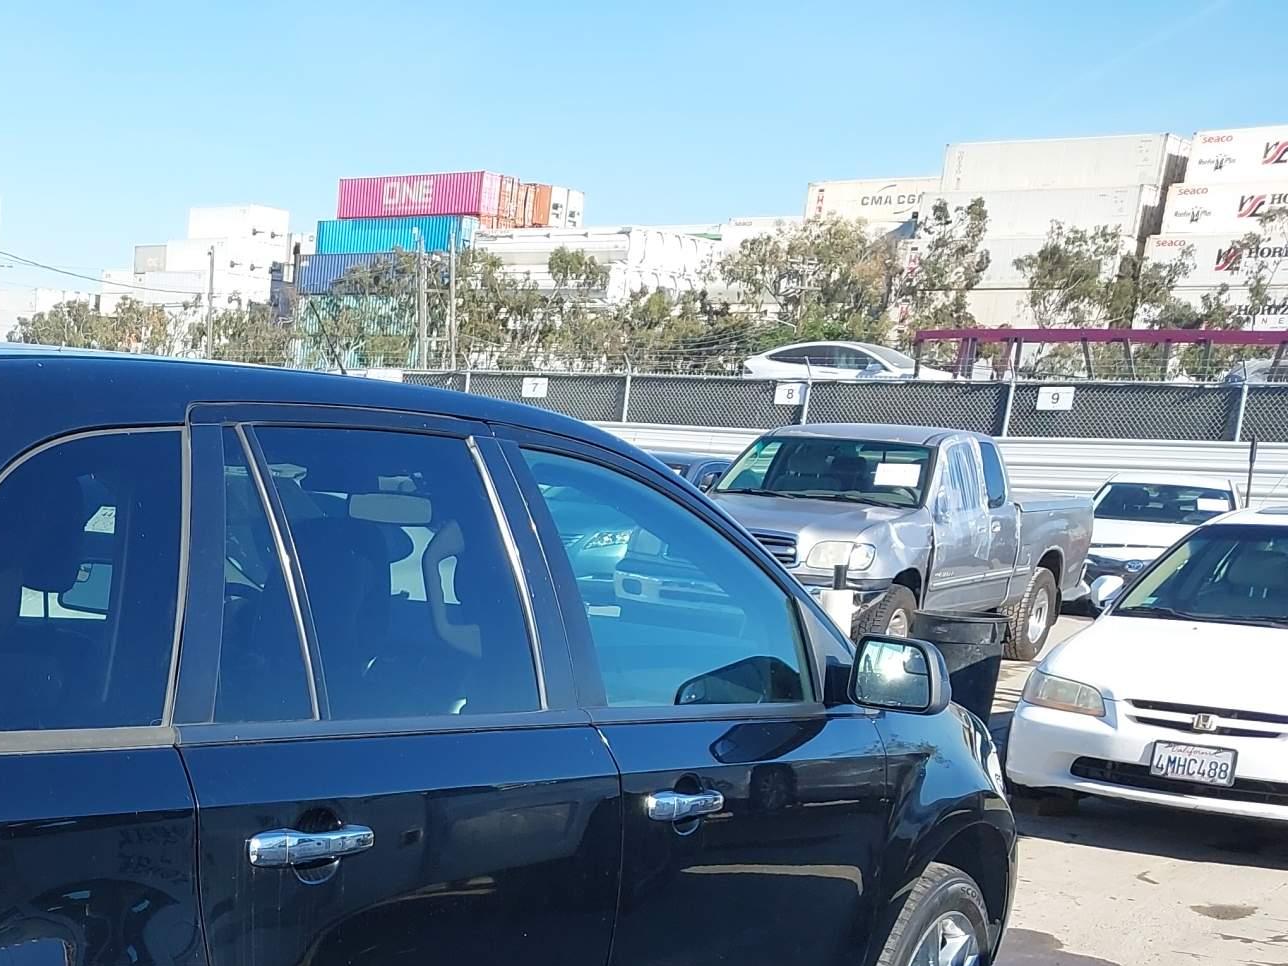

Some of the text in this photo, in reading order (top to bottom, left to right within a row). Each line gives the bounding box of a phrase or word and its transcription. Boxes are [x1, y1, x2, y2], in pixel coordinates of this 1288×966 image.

[1201, 134, 1234, 144] seaco
[383, 179, 434, 207] ONE
[1177, 187, 1209, 196] seaco
[861, 195, 892, 206] CMA
[1155, 240, 1186, 248] seaco
[532, 382, 539, 393] 7
[786, 388, 794, 400] 8
[1051, 392, 1060, 405] 9
[1155, 754, 1229, 780] 4MHC488
